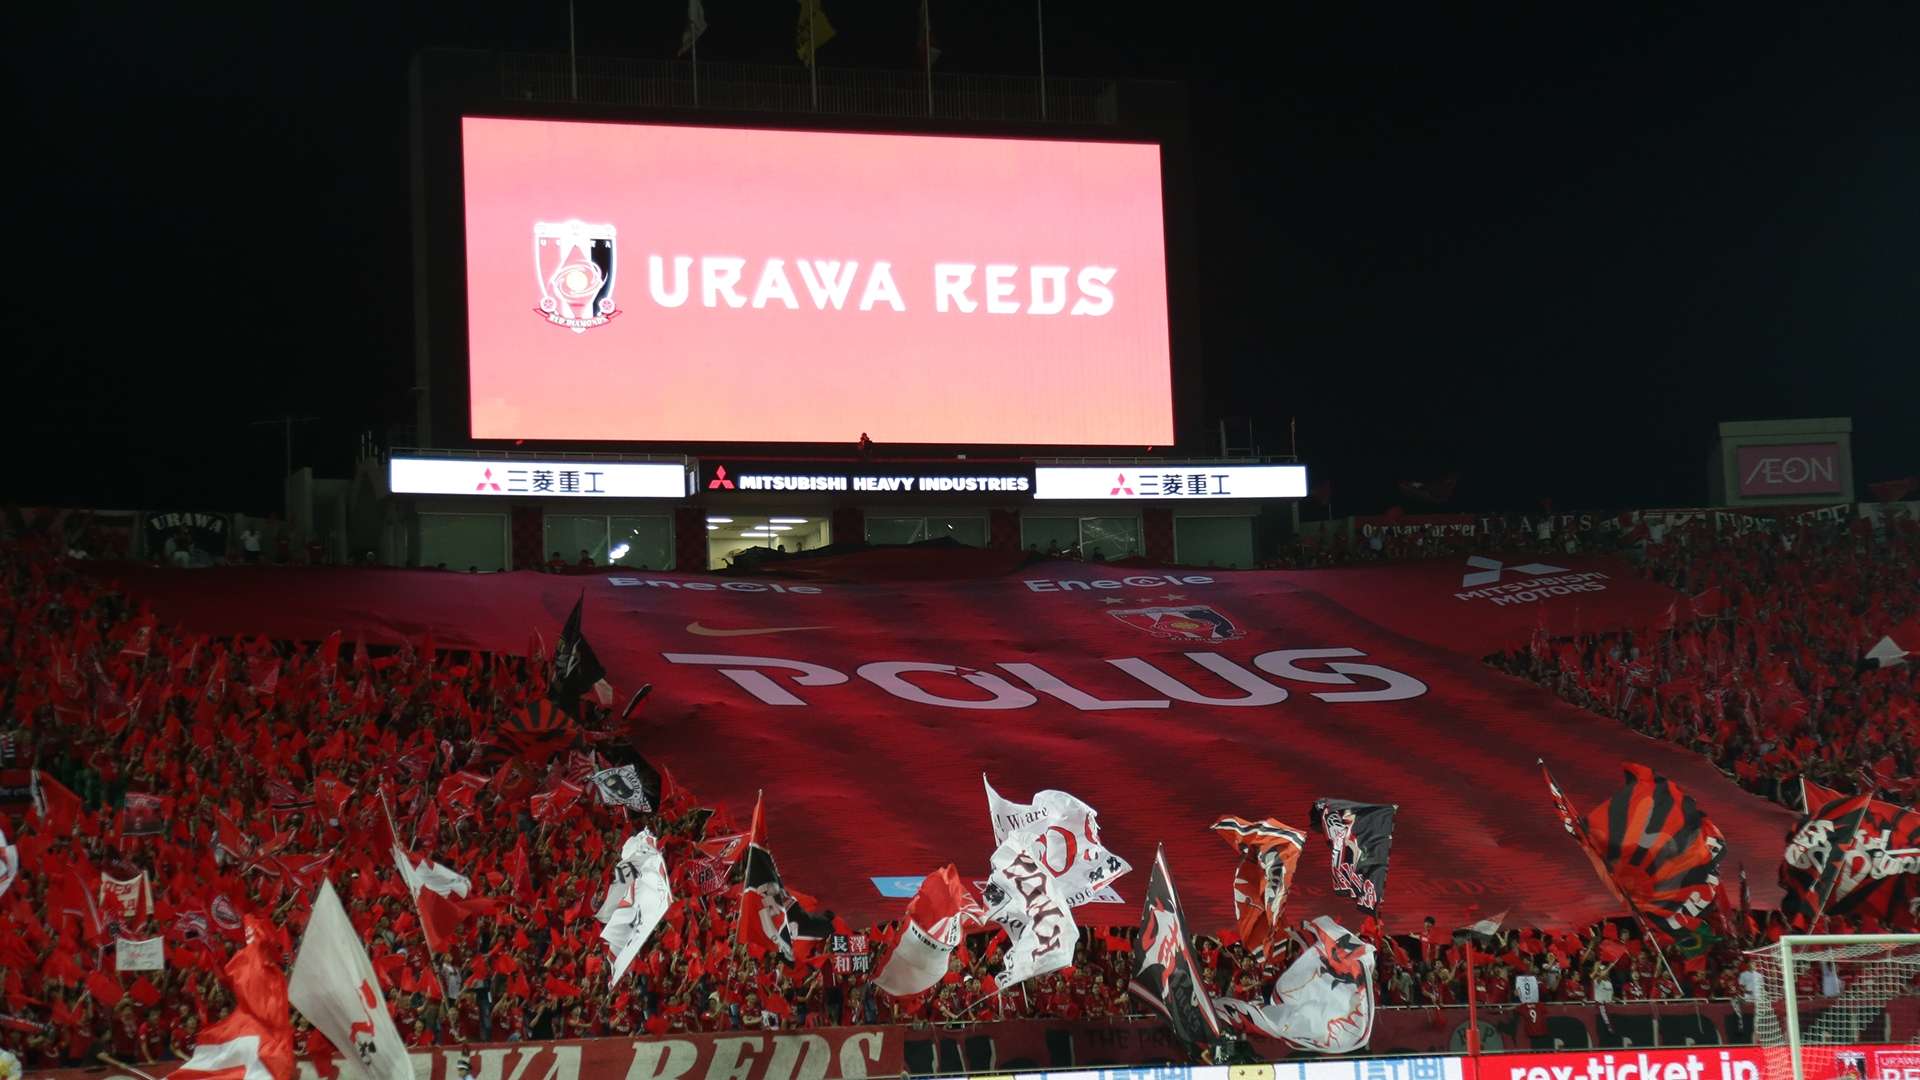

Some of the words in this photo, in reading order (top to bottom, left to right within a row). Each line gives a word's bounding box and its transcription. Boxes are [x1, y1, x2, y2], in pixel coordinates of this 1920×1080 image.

[649, 255, 906, 312] URAWA
[933, 263, 1118, 317] REDS
[507, 470, 605, 493] 三菱重工
[739, 476, 847, 491] MITSUBISHI
[853, 477, 914, 491] HEAVY
[919, 477, 1029, 491] INDUSTRIES
[1139, 474, 1231, 496] 三菱重工
[150, 513, 224, 533] URAWA
[1453, 571, 1612, 600] MITSUBISHI
[1490, 581, 1607, 606] MOTORS
[662, 647, 1428, 711] POLUS
